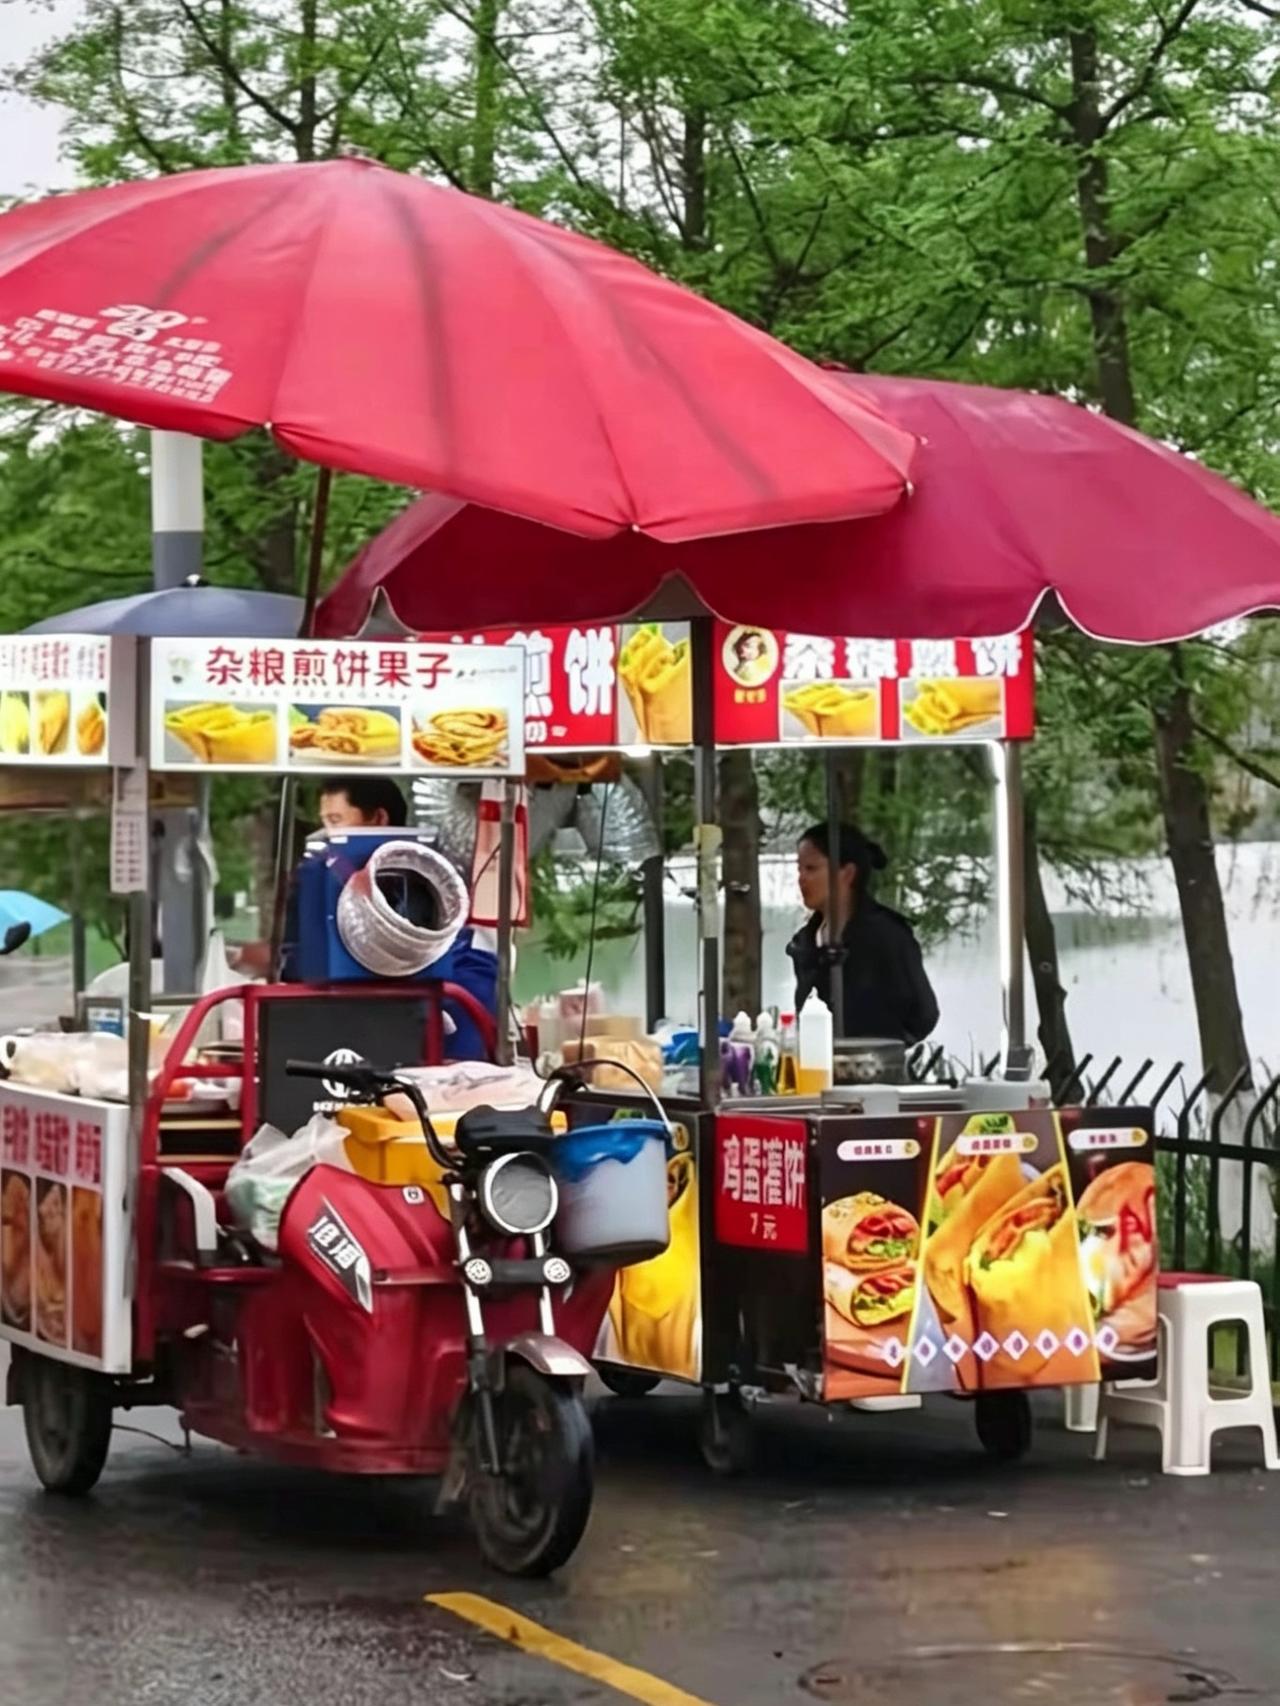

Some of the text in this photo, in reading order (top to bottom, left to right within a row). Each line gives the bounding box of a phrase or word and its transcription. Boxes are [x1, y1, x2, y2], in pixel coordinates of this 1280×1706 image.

[206, 646, 452, 689] 杂粮煎饼果子
[722, 1134, 805, 1209] 鸡蛋灌饼
